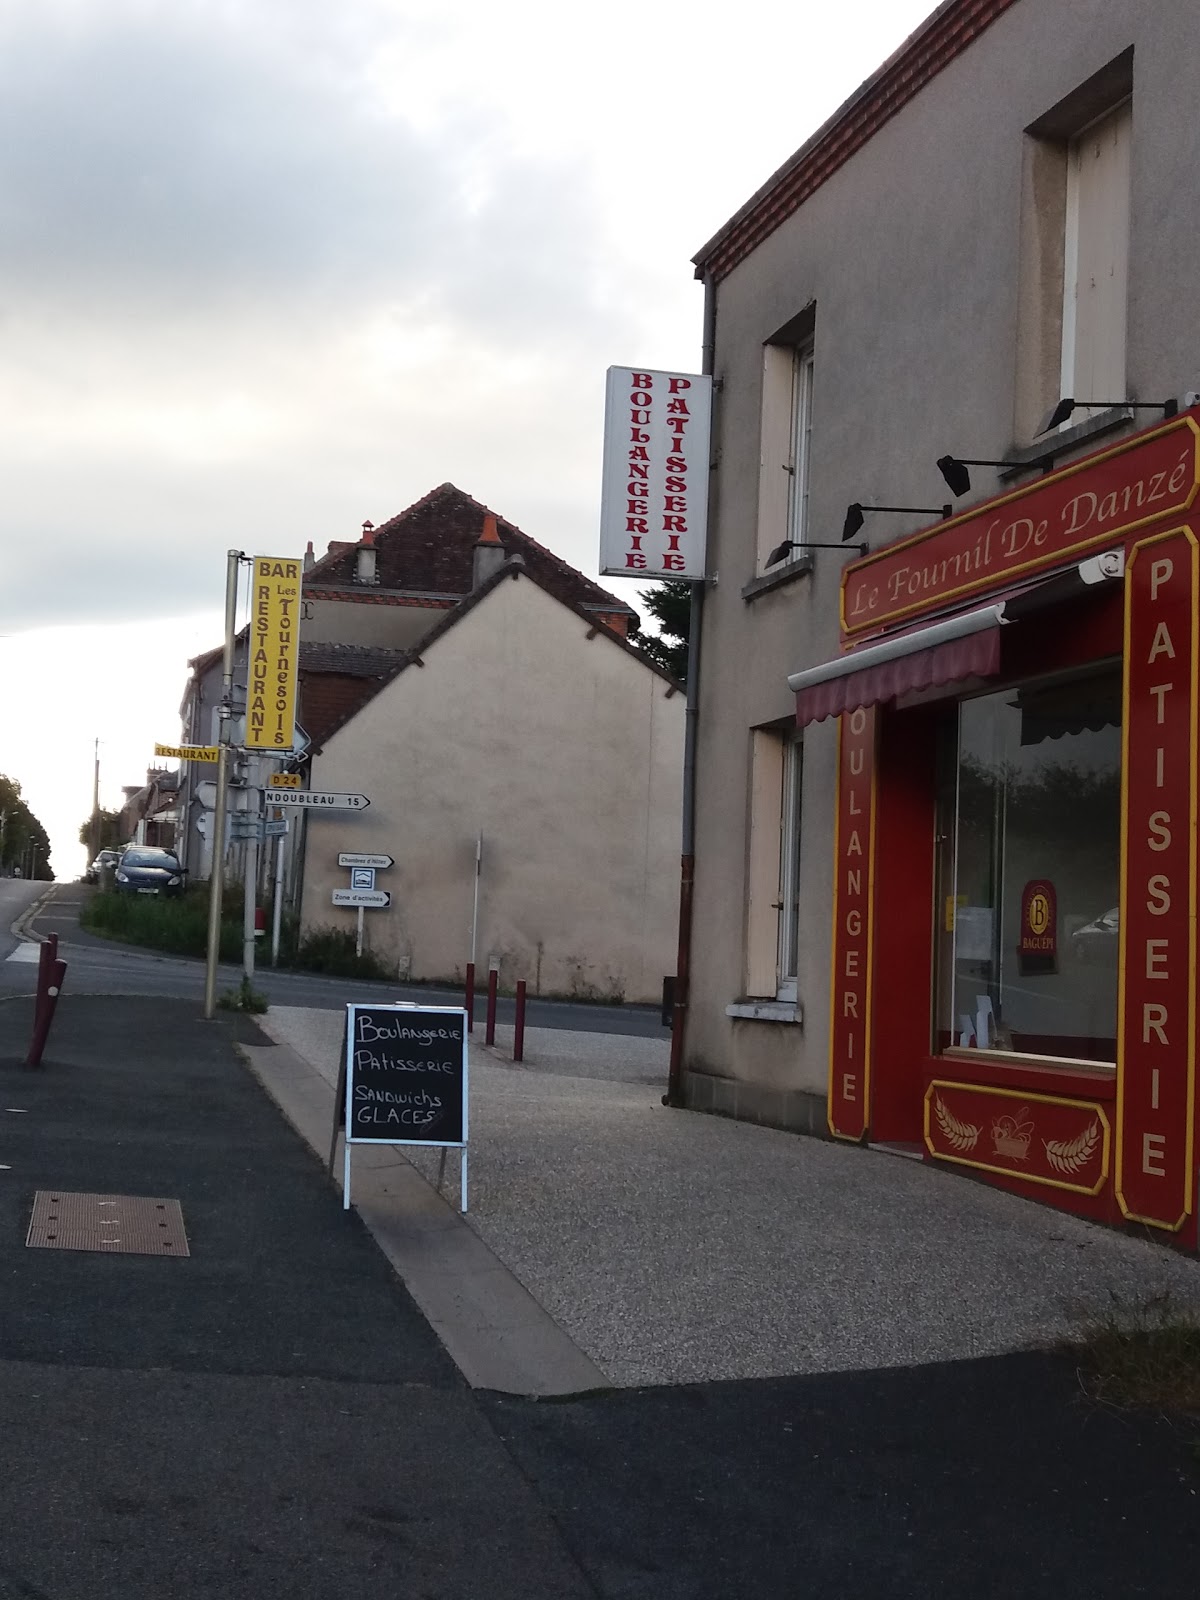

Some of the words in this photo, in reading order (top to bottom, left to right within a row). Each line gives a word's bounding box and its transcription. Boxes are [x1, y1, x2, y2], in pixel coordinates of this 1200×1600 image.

[625, 372, 653, 569] BOULANGERIE
[661, 377, 691, 571] PATISSERIE
[850, 582, 879, 617] Le
[887, 519, 1000, 601] Fournil
[1001, 515, 1048, 558] De
[1061, 449, 1190, 536] Danzé
[259, 562, 298, 579] BAR
[277, 584, 297, 596] Les
[251, 585, 271, 742] RESTAURANT
[274, 598, 295, 744] Tournesols
[155, 747, 217, 761] RESTAURANT
[273, 776, 280, 785] D
[284, 776, 297, 785] 24
[266, 793, 335, 805] NDOUBLEAU
[347, 797, 360, 806] 15
[1141, 557, 1176, 1177] PATISSERIE
[335, 893, 351, 901] Zone
[842, 708, 866, 1102] OULANGERIE
[1034, 898, 1044, 926] B
[357, 1105, 436, 1125] GLACES
